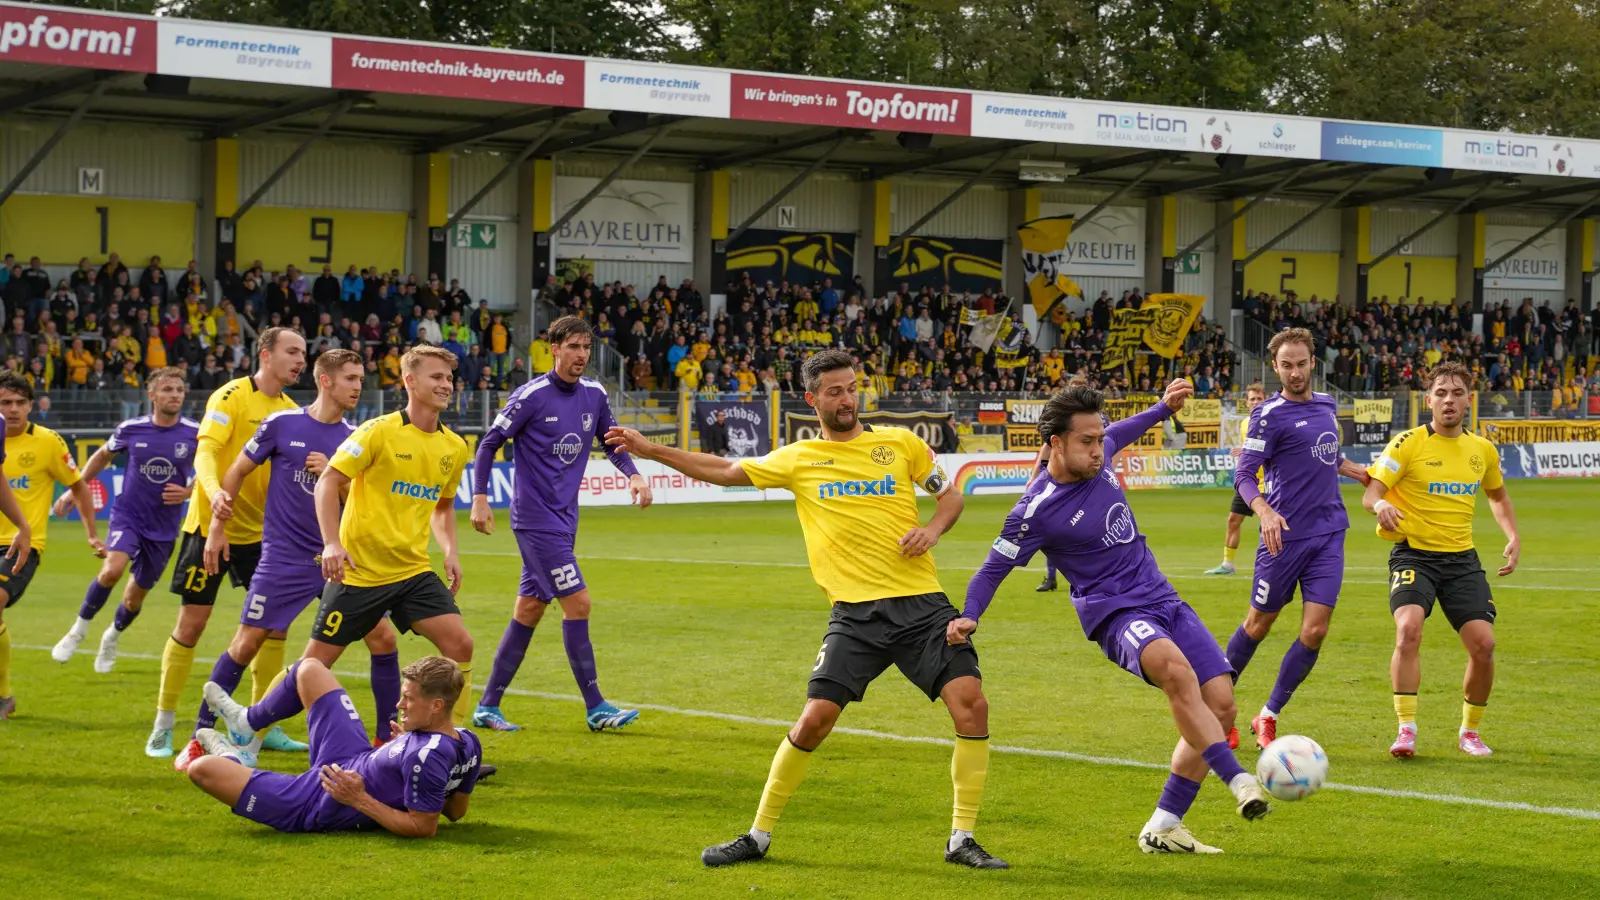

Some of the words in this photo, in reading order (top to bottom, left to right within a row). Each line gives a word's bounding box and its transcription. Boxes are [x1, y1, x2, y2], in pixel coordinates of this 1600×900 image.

[0, 15, 137, 56] pform!
[175, 35, 302, 56] Formentechnik
[236, 54, 312, 70] Bayreuth
[351, 52, 565, 86] formentechnik-bayreuth.de
[600, 73, 701, 90] Formentechnik
[649, 90, 711, 103] Bayreuth
[744, 88, 766, 101] Wir
[768, 91, 823, 107] bringen's
[825, 95, 837, 107] in
[847, 91, 958, 123] Topform!
[985, 105, 1068, 120] Formentechnik
[1025, 119, 1075, 132] Bayreuth
[1097, 112, 1187, 133] motion
[1097, 131, 1111, 140] FOR
[1115, 133, 1132, 142] MAN
[1154, 136, 1188, 146] MACHINE
[1259, 141, 1296, 151] schlaeger
[1336, 136, 1432, 151] schlaeger.com/karriere
[1465, 140, 1538, 158] motion
[82, 171, 100, 190] M
[781, 208, 792, 225] N
[96, 207, 109, 254] 1
[559, 221, 681, 245] BAYREUTH
[309, 218, 333, 263] 9
[1060, 242, 1136, 265] YREUTH
[1280, 258, 1296, 295] 2
[1404, 262, 1412, 298] 1
[1010, 433, 1044, 447] GEGE
[1186, 431, 1218, 445] REUTH
[140, 464, 177, 476] HYPDATA
[976, 465, 998, 479] SW
[1000, 464, 1033, 479] color
[1127, 456, 1149, 473] IST
[1153, 455, 1203, 472] UNSER
[818, 474, 896, 500] maxit
[1124, 472, 1215, 487] www.swcolor.de
[1069, 509, 1085, 527] JAKO
[111, 530, 123, 547] 7
[184, 565, 208, 592] 13
[551, 564, 580, 591] 22
[1390, 569, 1416, 593] 29
[1255, 578, 1270, 605] 3
[248, 594, 267, 620] 5
[322, 611, 343, 637] 9
[1124, 620, 1156, 649] 18
[246, 794, 257, 813] JAKO
